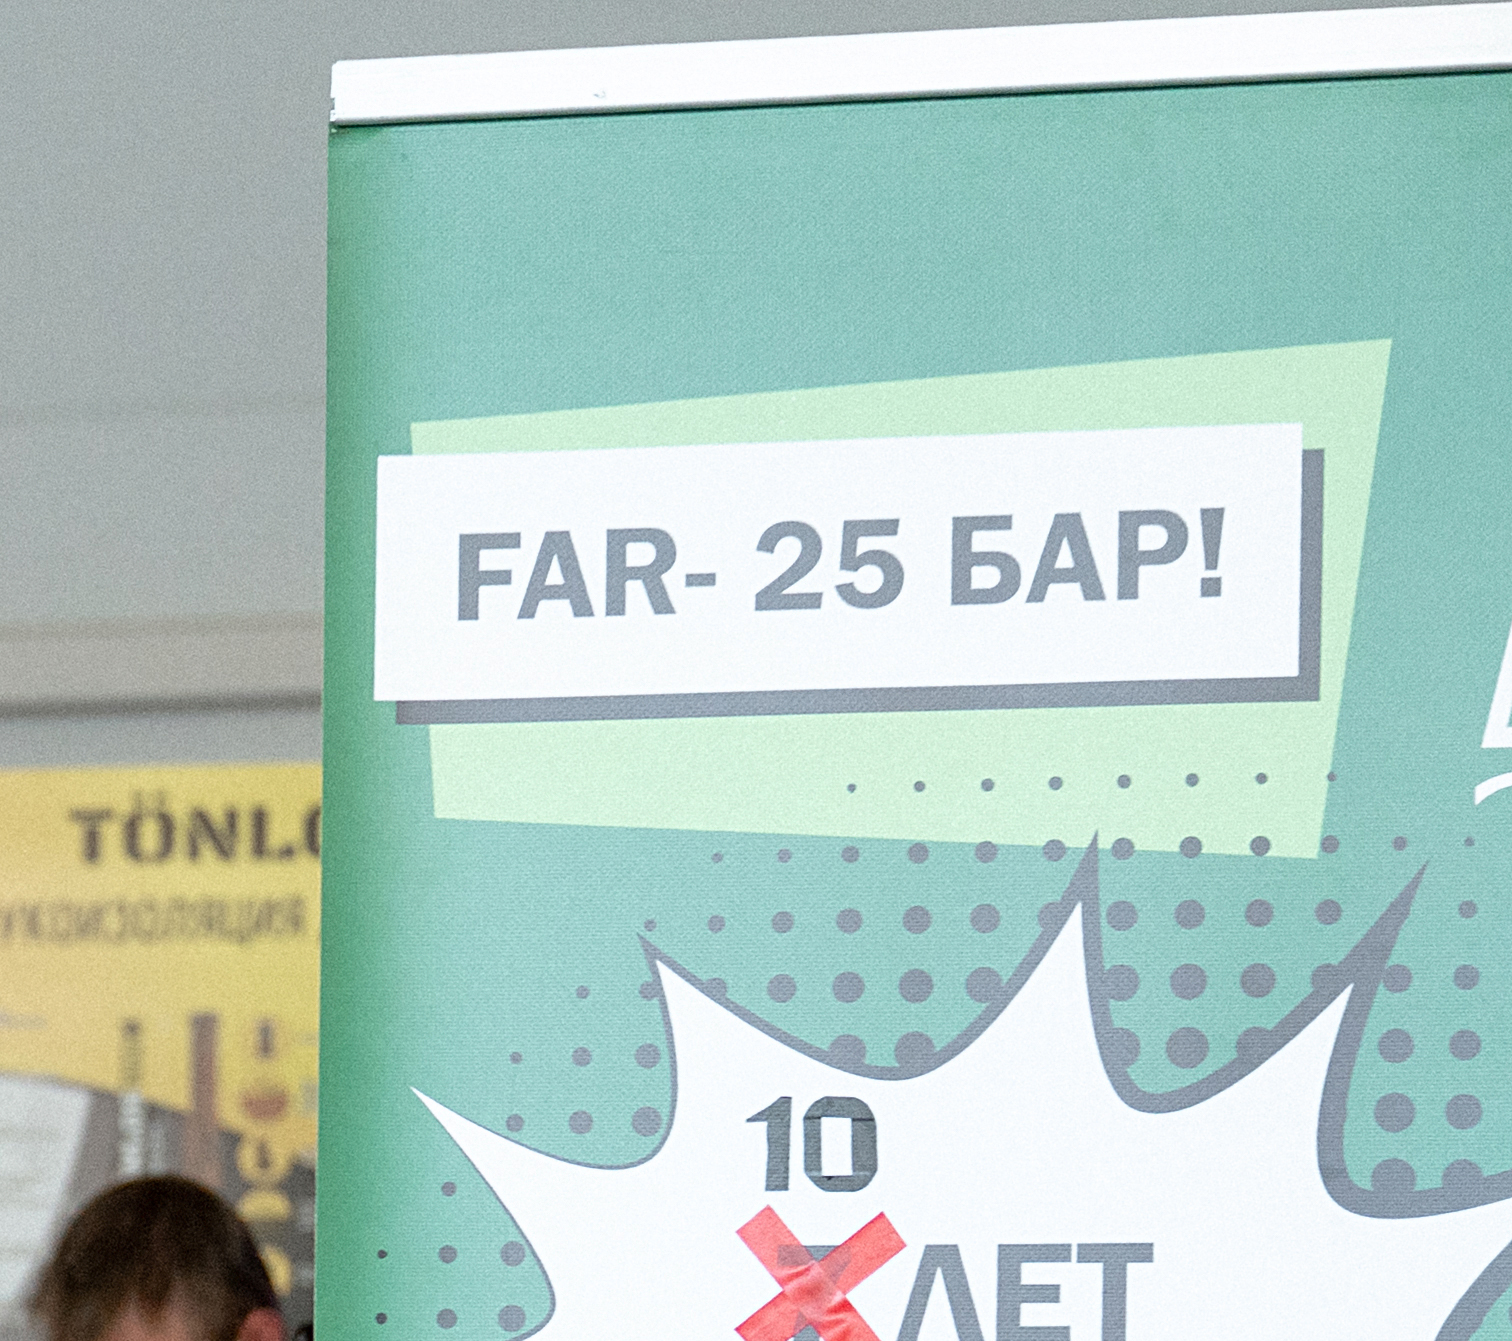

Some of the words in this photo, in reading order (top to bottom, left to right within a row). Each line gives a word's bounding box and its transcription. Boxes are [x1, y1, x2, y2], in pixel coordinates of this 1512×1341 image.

[456, 526, 716, 622] FAR-
[754, 518, 907, 612] 25
[948, 505, 1226, 607] БАР!
[745, 1095, 878, 1193] 10
